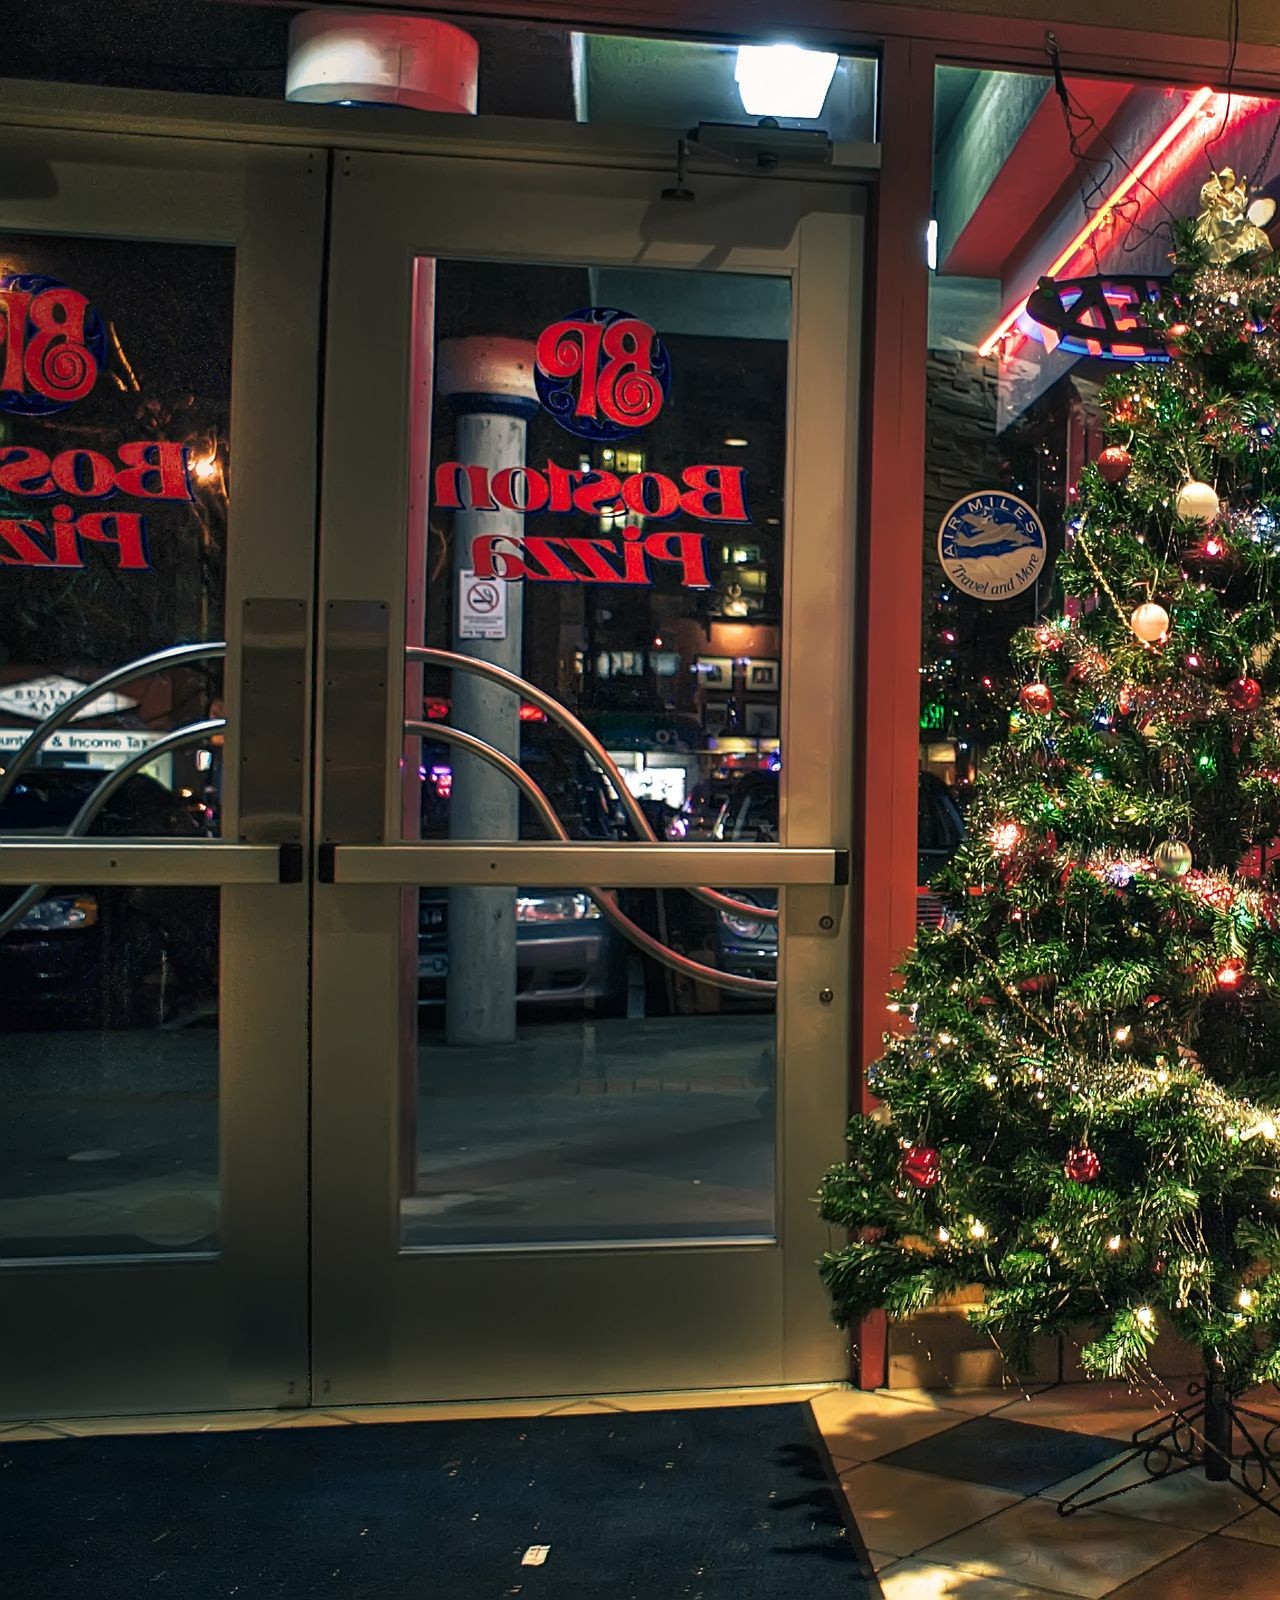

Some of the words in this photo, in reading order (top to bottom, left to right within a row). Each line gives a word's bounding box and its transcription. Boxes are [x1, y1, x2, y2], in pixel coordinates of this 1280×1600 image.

[943, 516, 962, 557] AIR
[967, 496, 1037, 534] MILES
[952, 564, 989, 595] Travel
[991, 578, 1015, 595] and
[1015, 553, 1040, 585] More
[51, 735, 63, 748] &
[68, 735, 122, 748] Income
